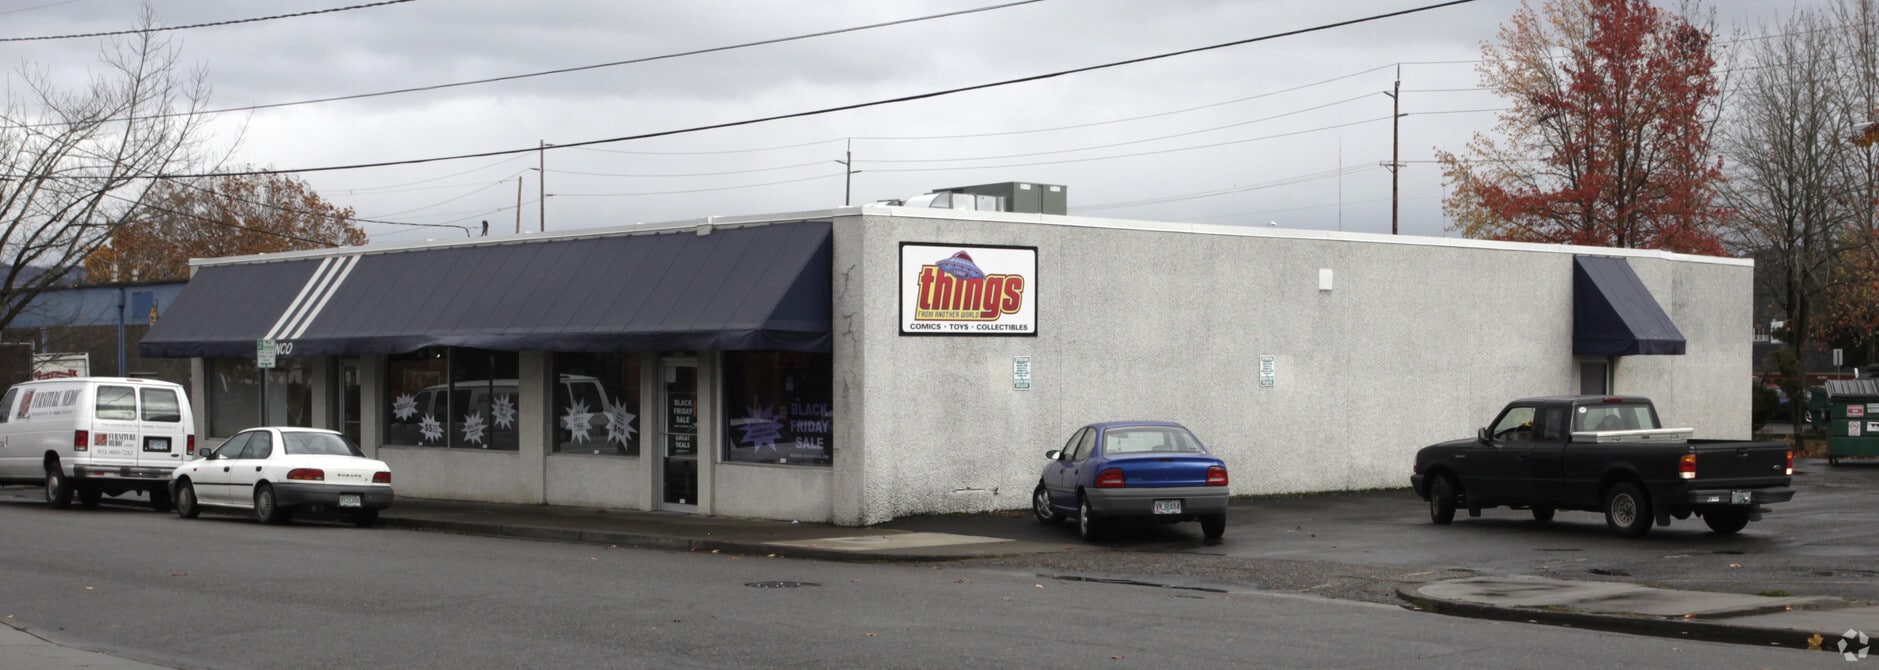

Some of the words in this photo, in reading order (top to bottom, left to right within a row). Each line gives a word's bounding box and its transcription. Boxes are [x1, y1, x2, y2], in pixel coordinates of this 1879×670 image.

[919, 268, 1021, 318] things
[976, 323, 1028, 331] COLLECTIBLES
[673, 407, 692, 415] FRIDAY
[791, 403, 828, 416] BLACK
[613, 423, 625, 435] $10
[791, 420, 829, 432] FRIDAY
[109, 432, 136, 441] FURNITURE
[795, 437, 824, 449] SALE
